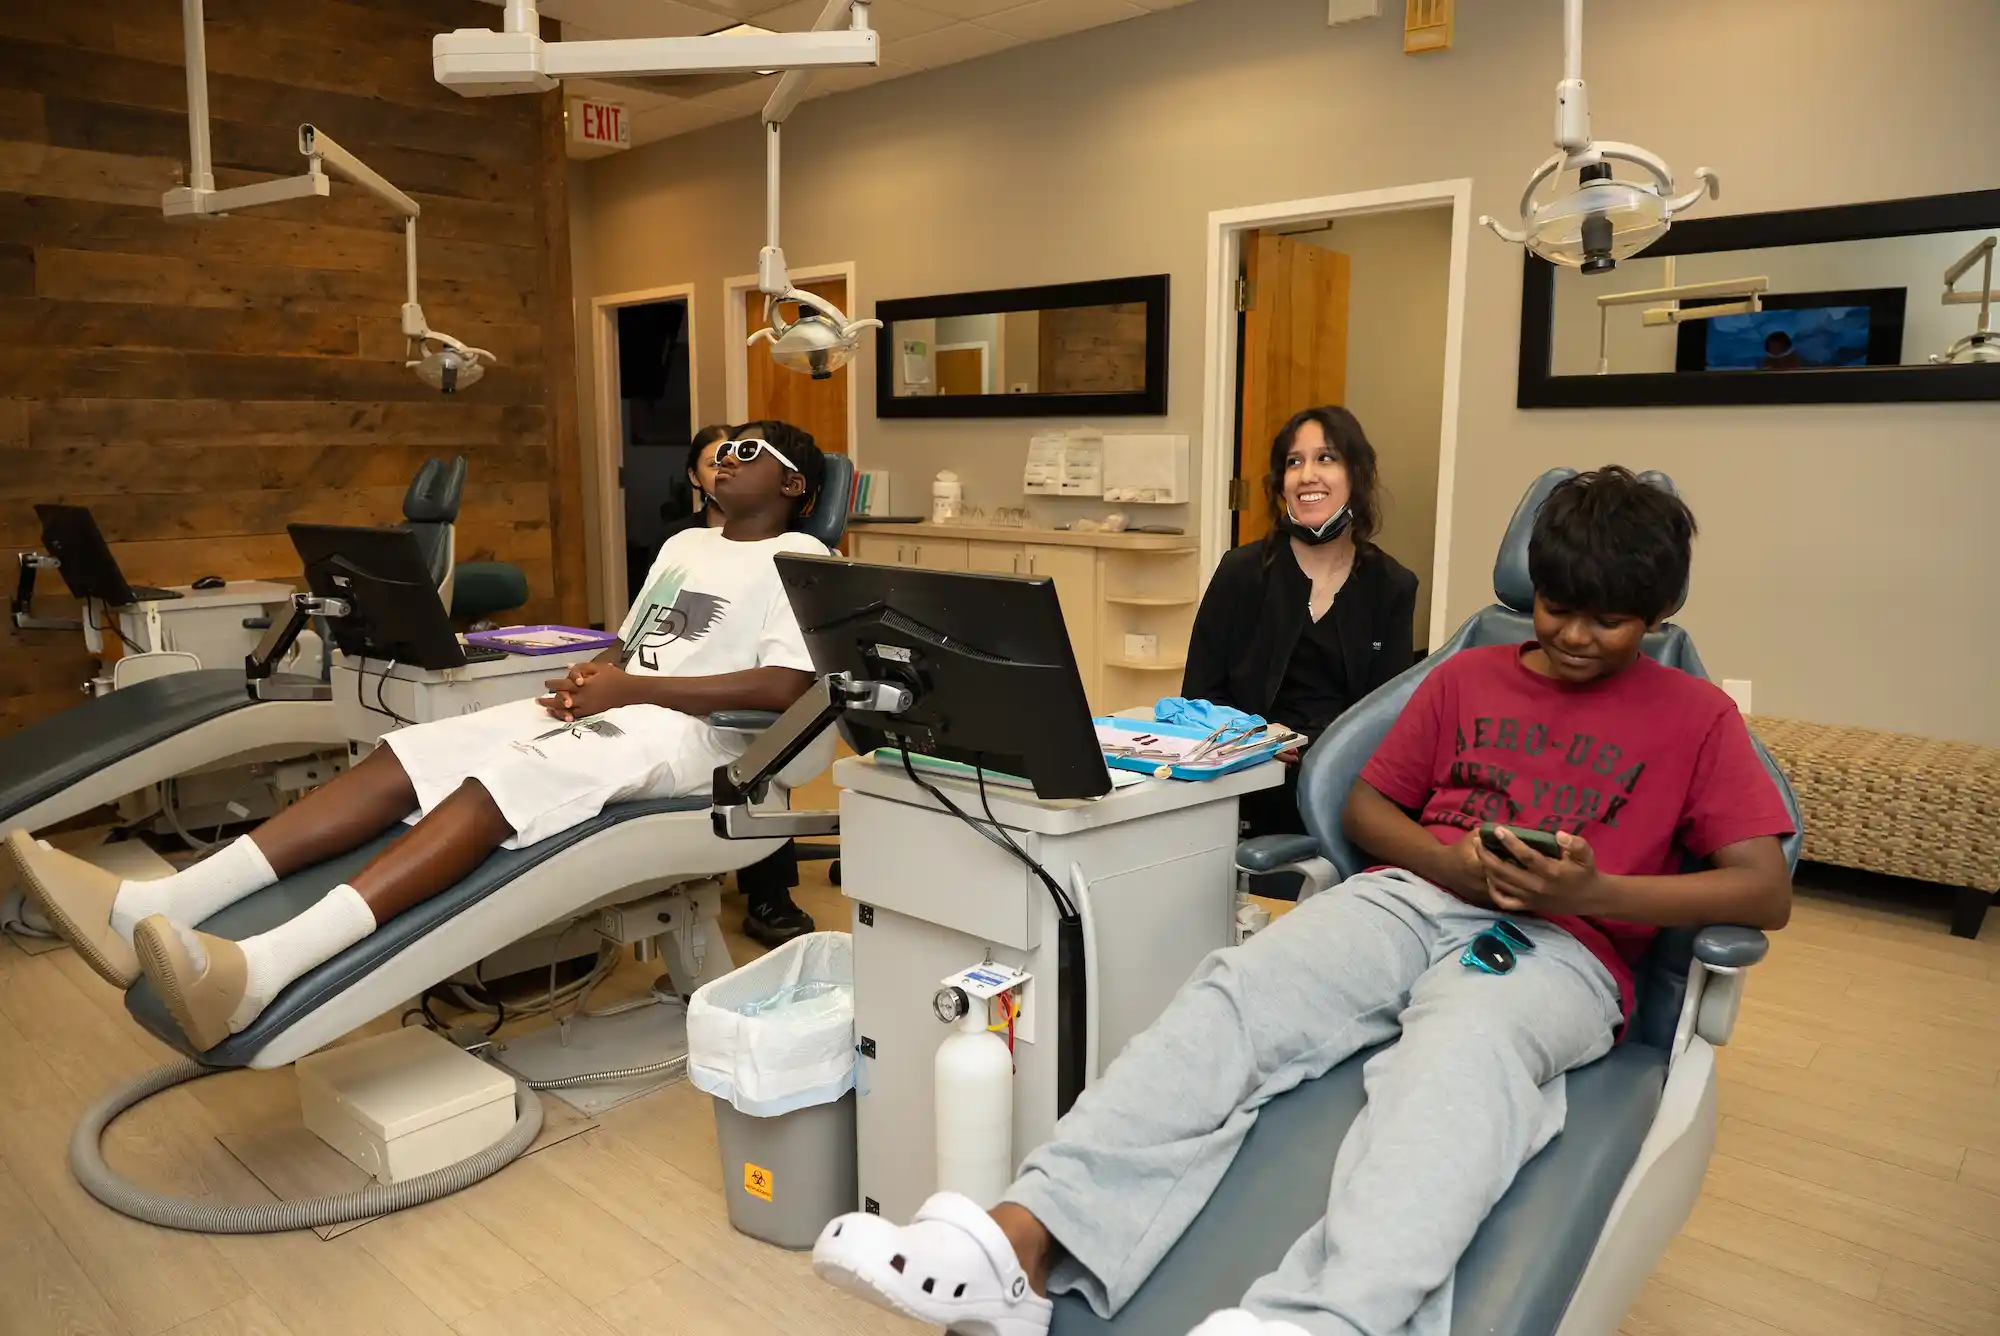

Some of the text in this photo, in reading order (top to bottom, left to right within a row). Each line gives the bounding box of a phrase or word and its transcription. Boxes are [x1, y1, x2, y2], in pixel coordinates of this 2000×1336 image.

[583, 103, 620, 142] EXIT
[1455, 717, 1645, 793] AERO-USA
[1530, 777, 1629, 828] YORK
